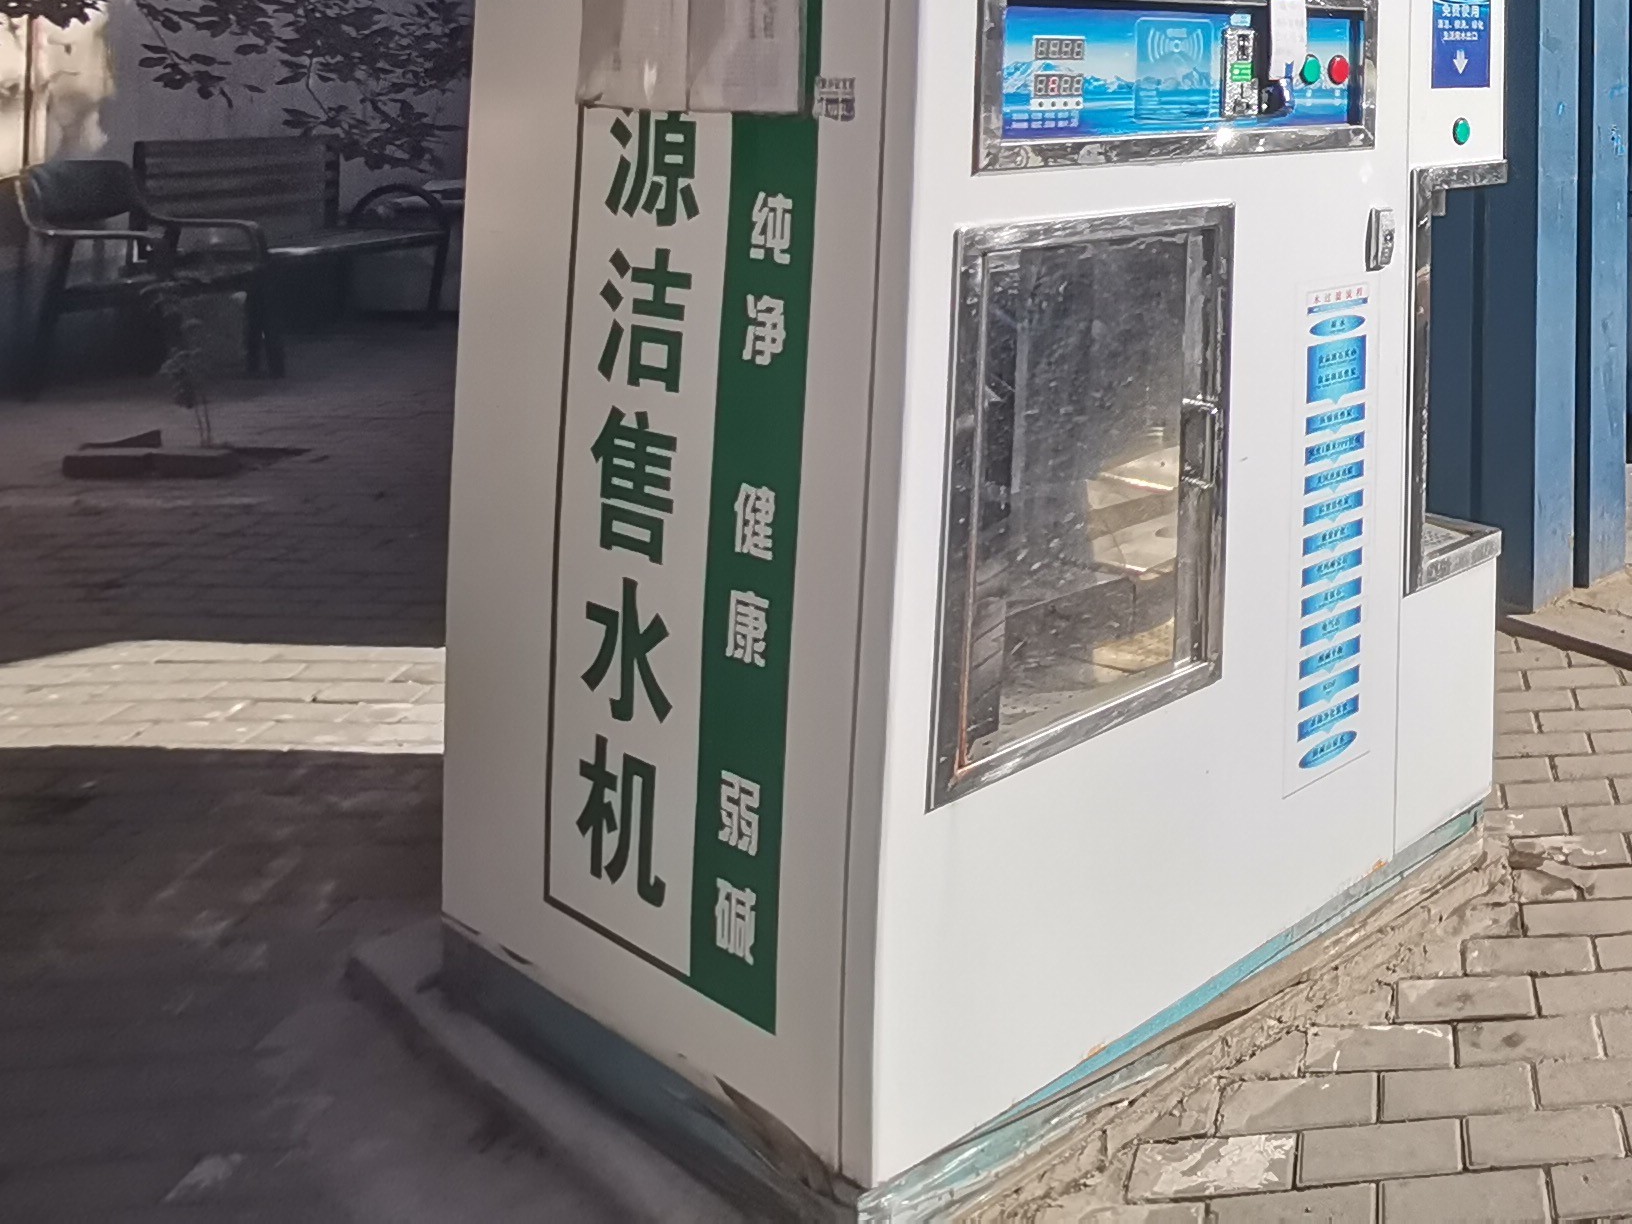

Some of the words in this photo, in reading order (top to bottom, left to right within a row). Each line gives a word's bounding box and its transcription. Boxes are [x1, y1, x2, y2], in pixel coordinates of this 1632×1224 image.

[742, 192, 792, 365] 纯净
[576, 108, 700, 908] 源洁售水机
[725, 482, 775, 667] 健康
[715, 770, 760, 965] 弱碱
